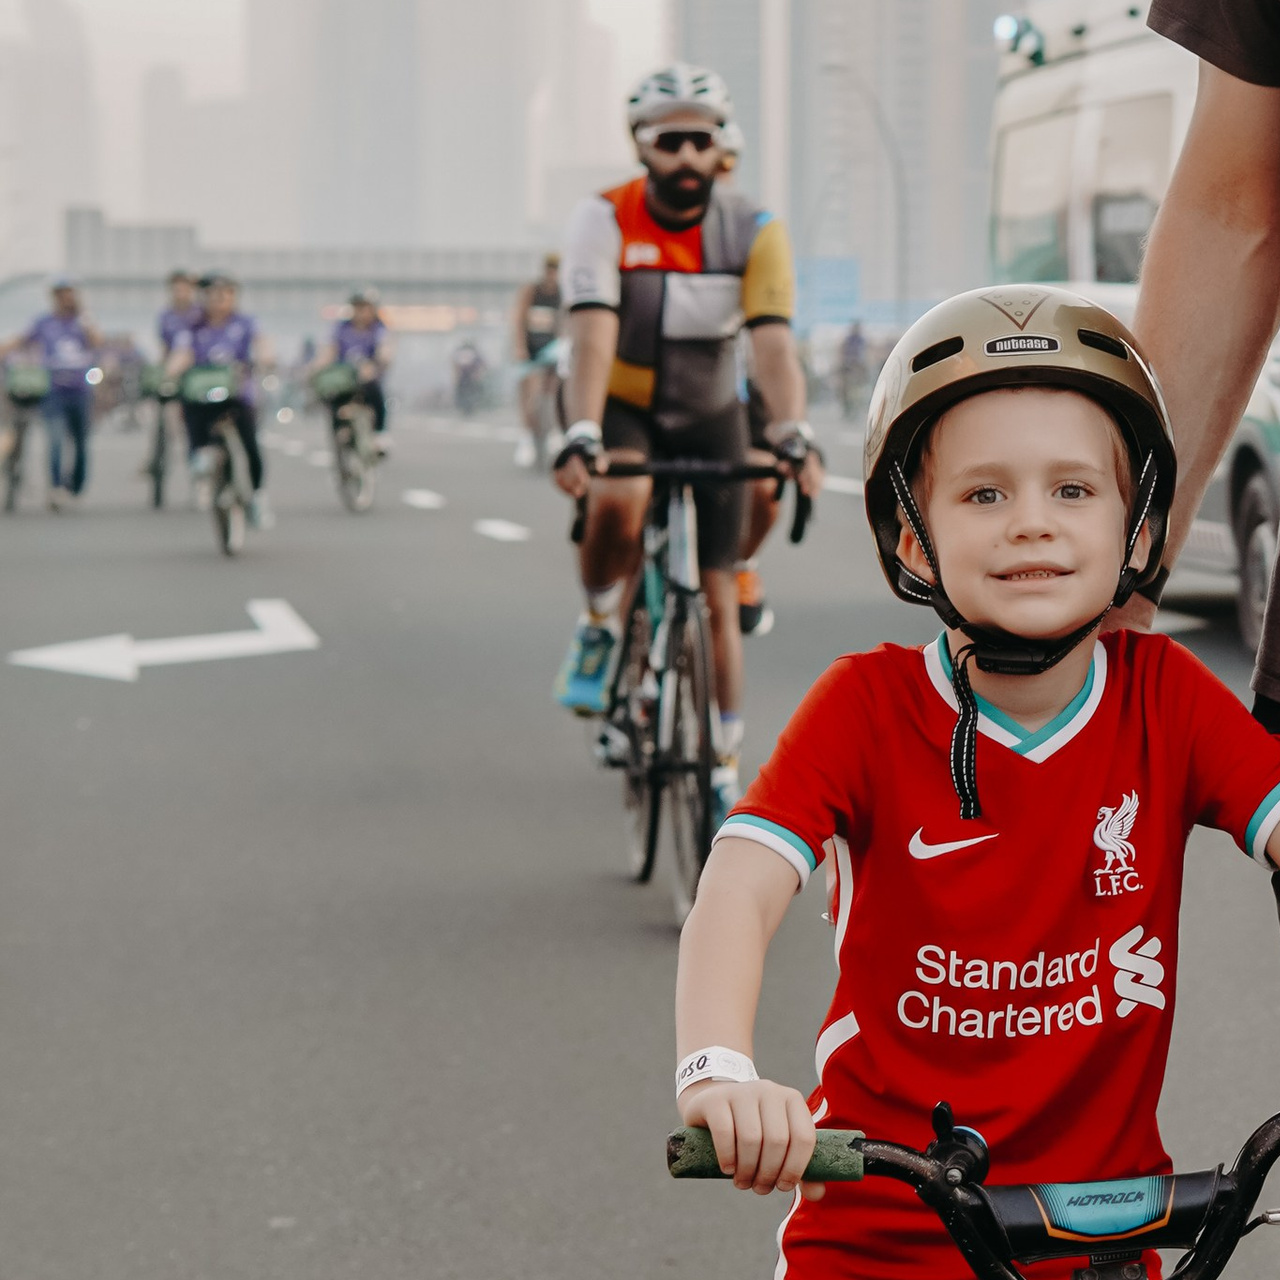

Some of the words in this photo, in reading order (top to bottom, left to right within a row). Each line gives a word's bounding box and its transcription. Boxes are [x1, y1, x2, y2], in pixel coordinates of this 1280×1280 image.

[995, 338, 1049, 351] nutcase
[1094, 872, 1144, 896] L.F.C.
[915, 937, 1100, 990] Standard
[897, 984, 1103, 1039] Chartered
[1067, 1191, 1145, 1207] HOTROCK
